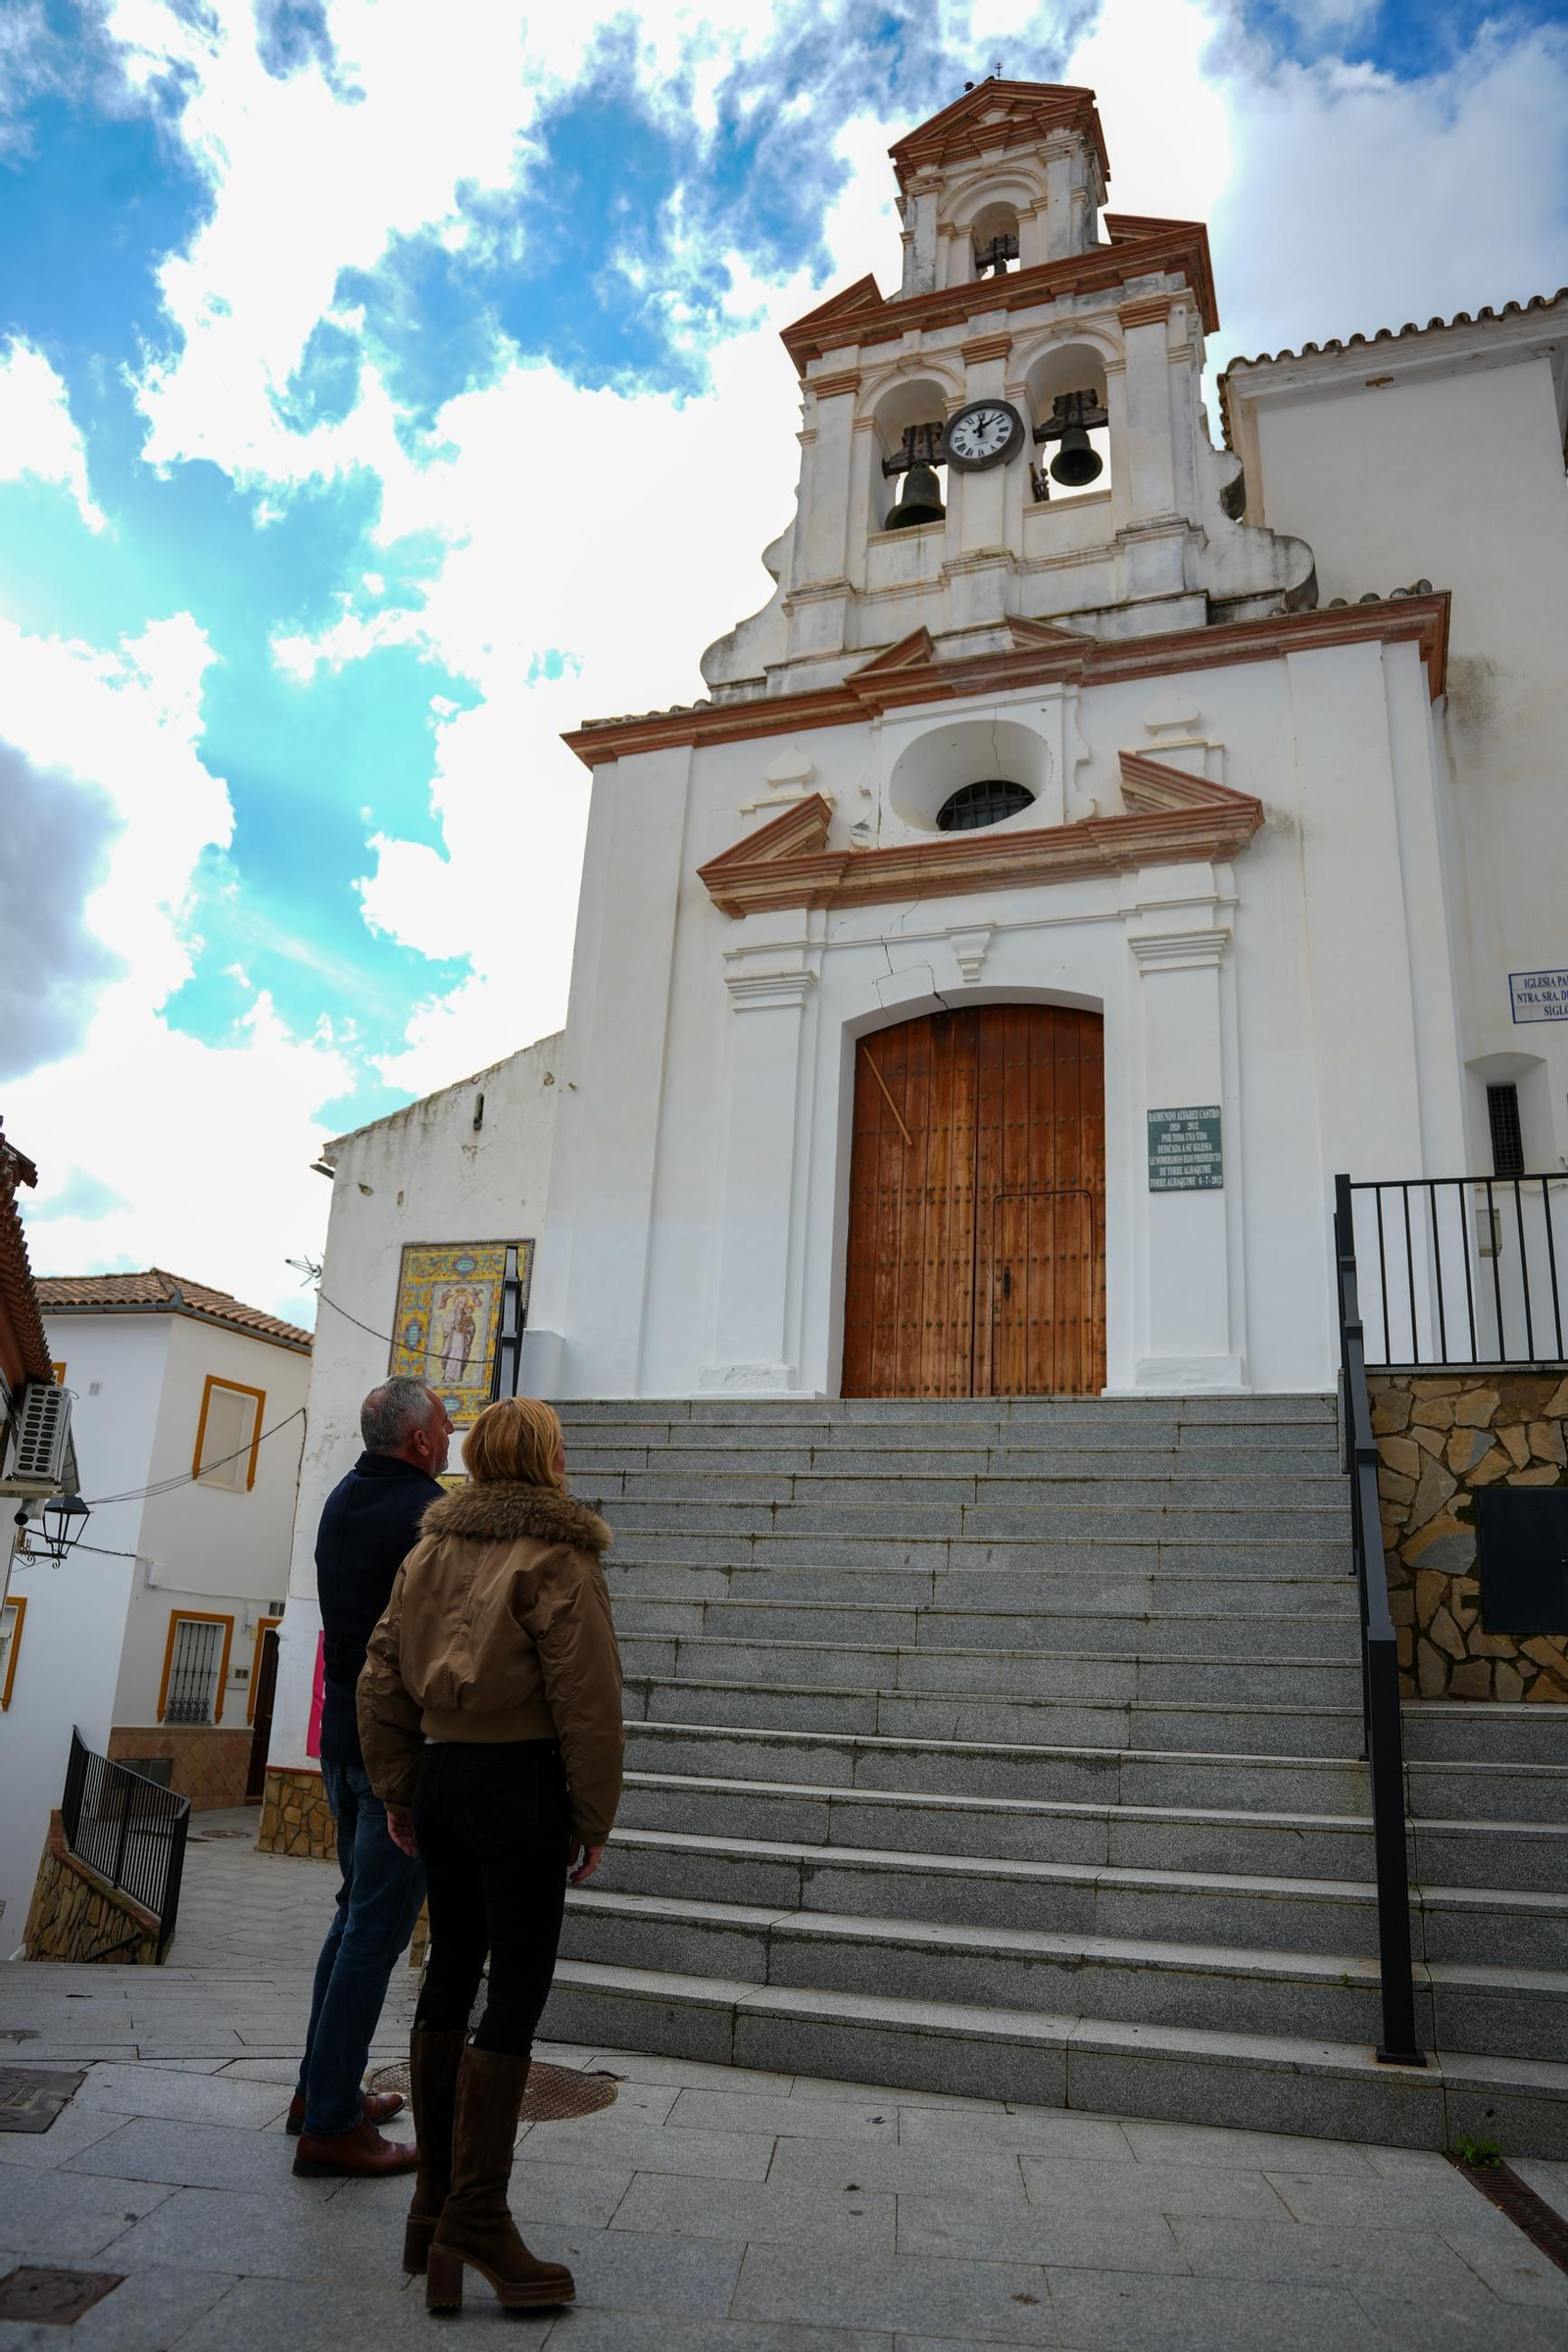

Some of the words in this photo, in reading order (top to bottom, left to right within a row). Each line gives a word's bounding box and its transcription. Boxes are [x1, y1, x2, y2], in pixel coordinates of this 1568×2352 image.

[1524, 976, 1556, 989] IGLESIA
[1557, 975, 1568, 986] PA
[1517, 992, 1541, 1004] NTRA.
[1542, 991, 1559, 1002] SRA.
[1560, 990, 1568, 1001] D
[1177, 1109, 1199, 1121] ALVAREZ
[1199, 1108, 1220, 1119] CASTRO
[1161, 1133, 1172, 1143] POR
[1172, 1133, 1185, 1142] TODA
[1185, 1132, 1196, 1142] UNA
[1196, 1131, 1207, 1141] VIDA
[1157, 1144, 1181, 1154] DEDICADA
[1186, 1144, 1193, 1152] SU
[1193, 1143, 1212, 1152] IGLESIA
[1155, 1155, 1182, 1165] NOMBRAMOS
[1159, 1166, 1166, 1176] DE
[1167, 1165, 1183, 1176] TORRE
[1184, 1164, 1211, 1176] ALHAQUIME
[1150, 1177, 1166, 1188] TORRE
[1167, 1176, 1196, 1188] ALHAQUIME
